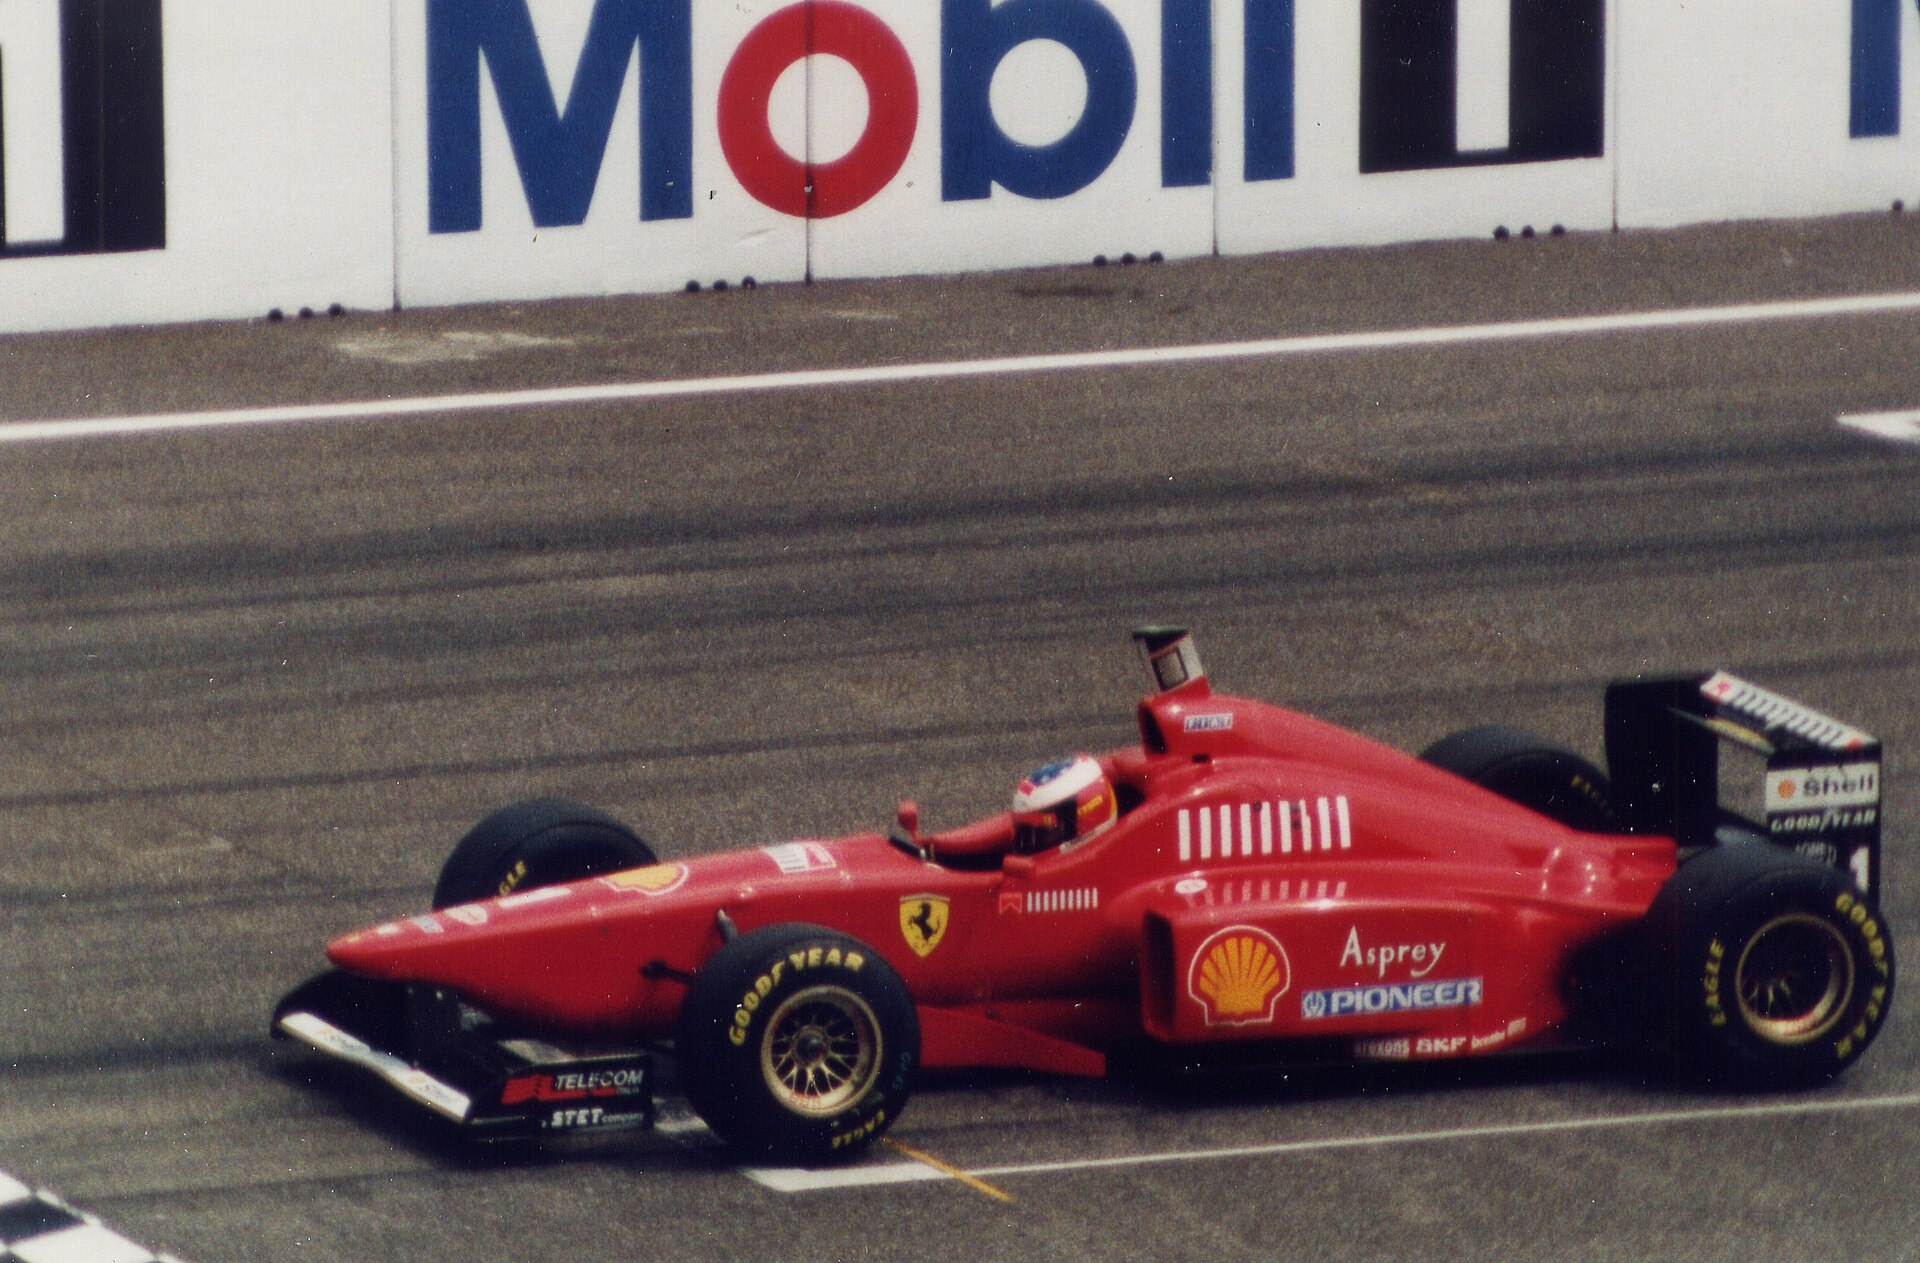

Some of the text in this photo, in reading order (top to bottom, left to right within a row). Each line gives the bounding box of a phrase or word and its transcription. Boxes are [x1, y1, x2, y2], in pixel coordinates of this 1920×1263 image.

[1803, 774, 1874, 796] Shell
[1339, 925, 1447, 979] Asprey
[1331, 980, 1482, 1014] PIONEER
[556, 1069, 644, 1090] TELECOM
[551, 1107, 604, 1128] STET
